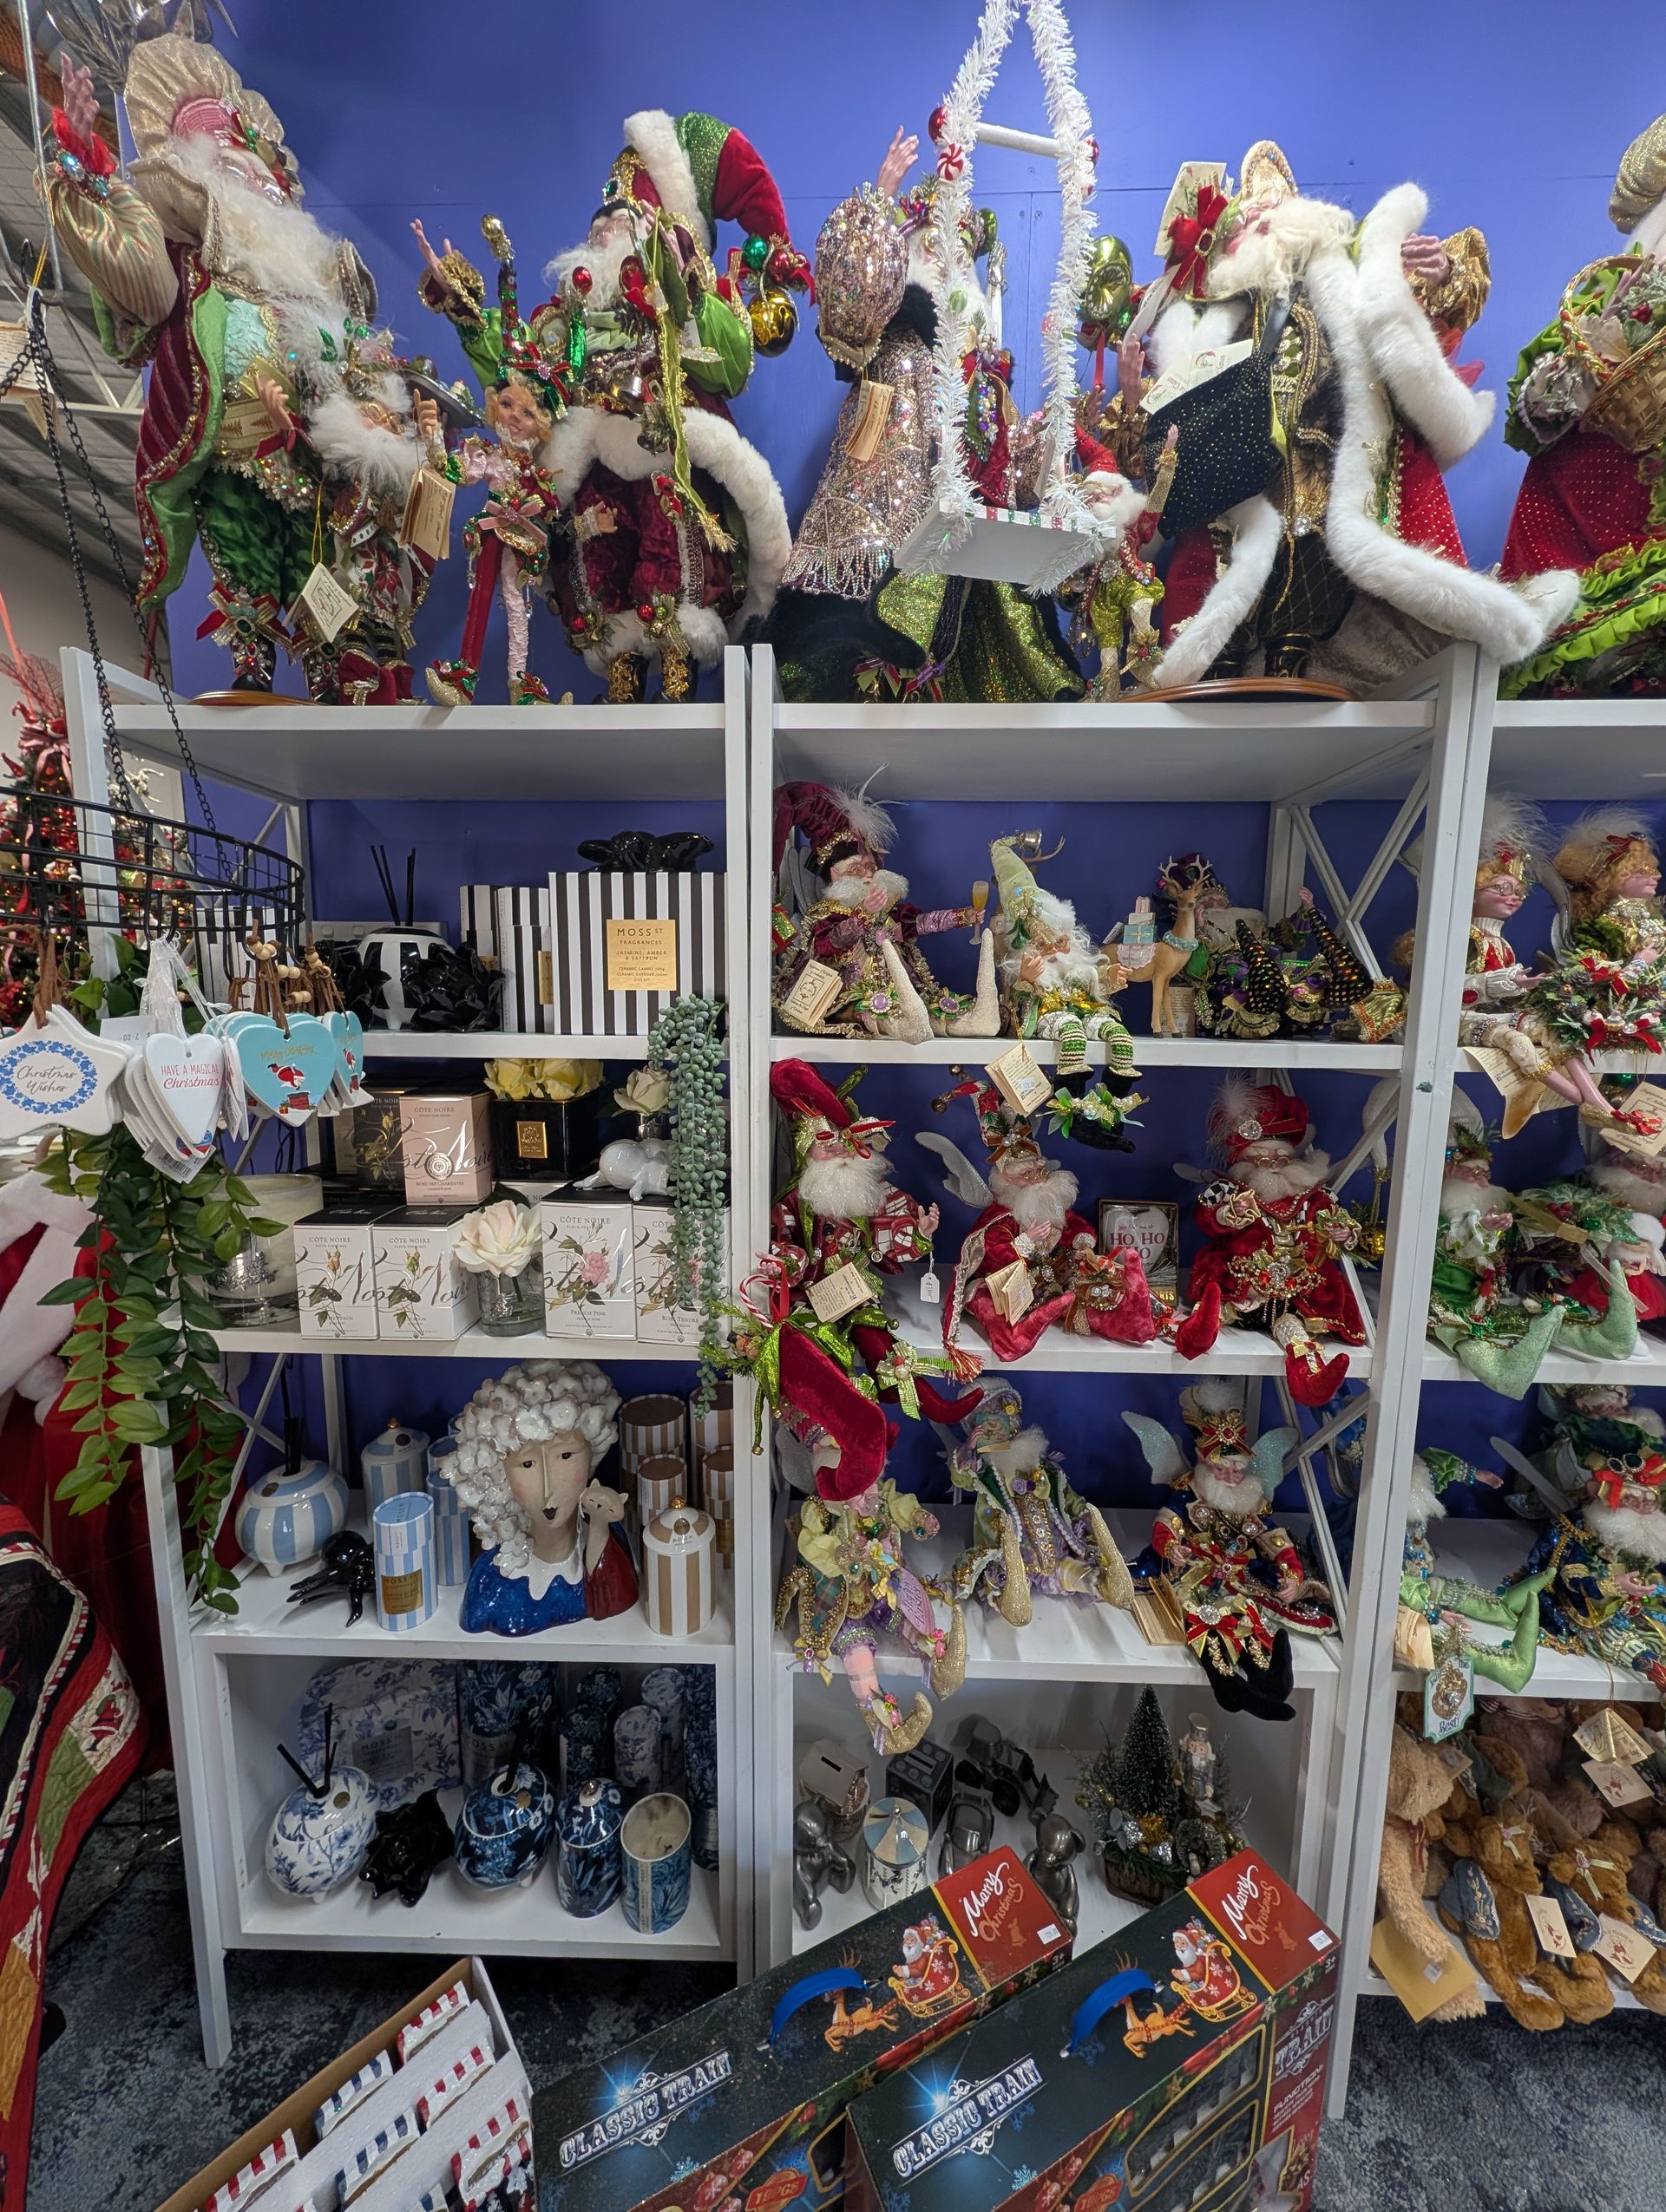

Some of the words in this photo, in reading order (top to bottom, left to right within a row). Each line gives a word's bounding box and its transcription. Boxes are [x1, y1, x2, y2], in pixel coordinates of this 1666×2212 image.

[617, 928, 651, 937] MOSS
[17, 1065, 77, 1079] Christmas
[27, 1080, 69, 1095] Wishes
[161, 1064, 180, 1077] HAVE
[183, 1064, 188, 1074] A
[190, 1063, 220, 1075] MAGICAL
[163, 1077, 220, 1090] Christmas
[560, 1214, 582, 1224] CÔTE
[1110, 1233, 1135, 1246] HO
[1141, 1232, 1165, 1245] HO
[961, 1862, 1010, 1938] Merry
[979, 1875, 1024, 1942] Christmas
[1221, 1865, 1259, 1940] Merry
[1243, 1880, 1281, 1945] Christmas
[1275, 2005, 1334, 2077] TRAIN
[559, 2091, 660, 2169] CLASSIC
[661, 2051, 732, 2111] TRAIN
[892, 2099, 982, 2177] CLASSIC
[976, 2058, 1043, 2117] TRAIN
